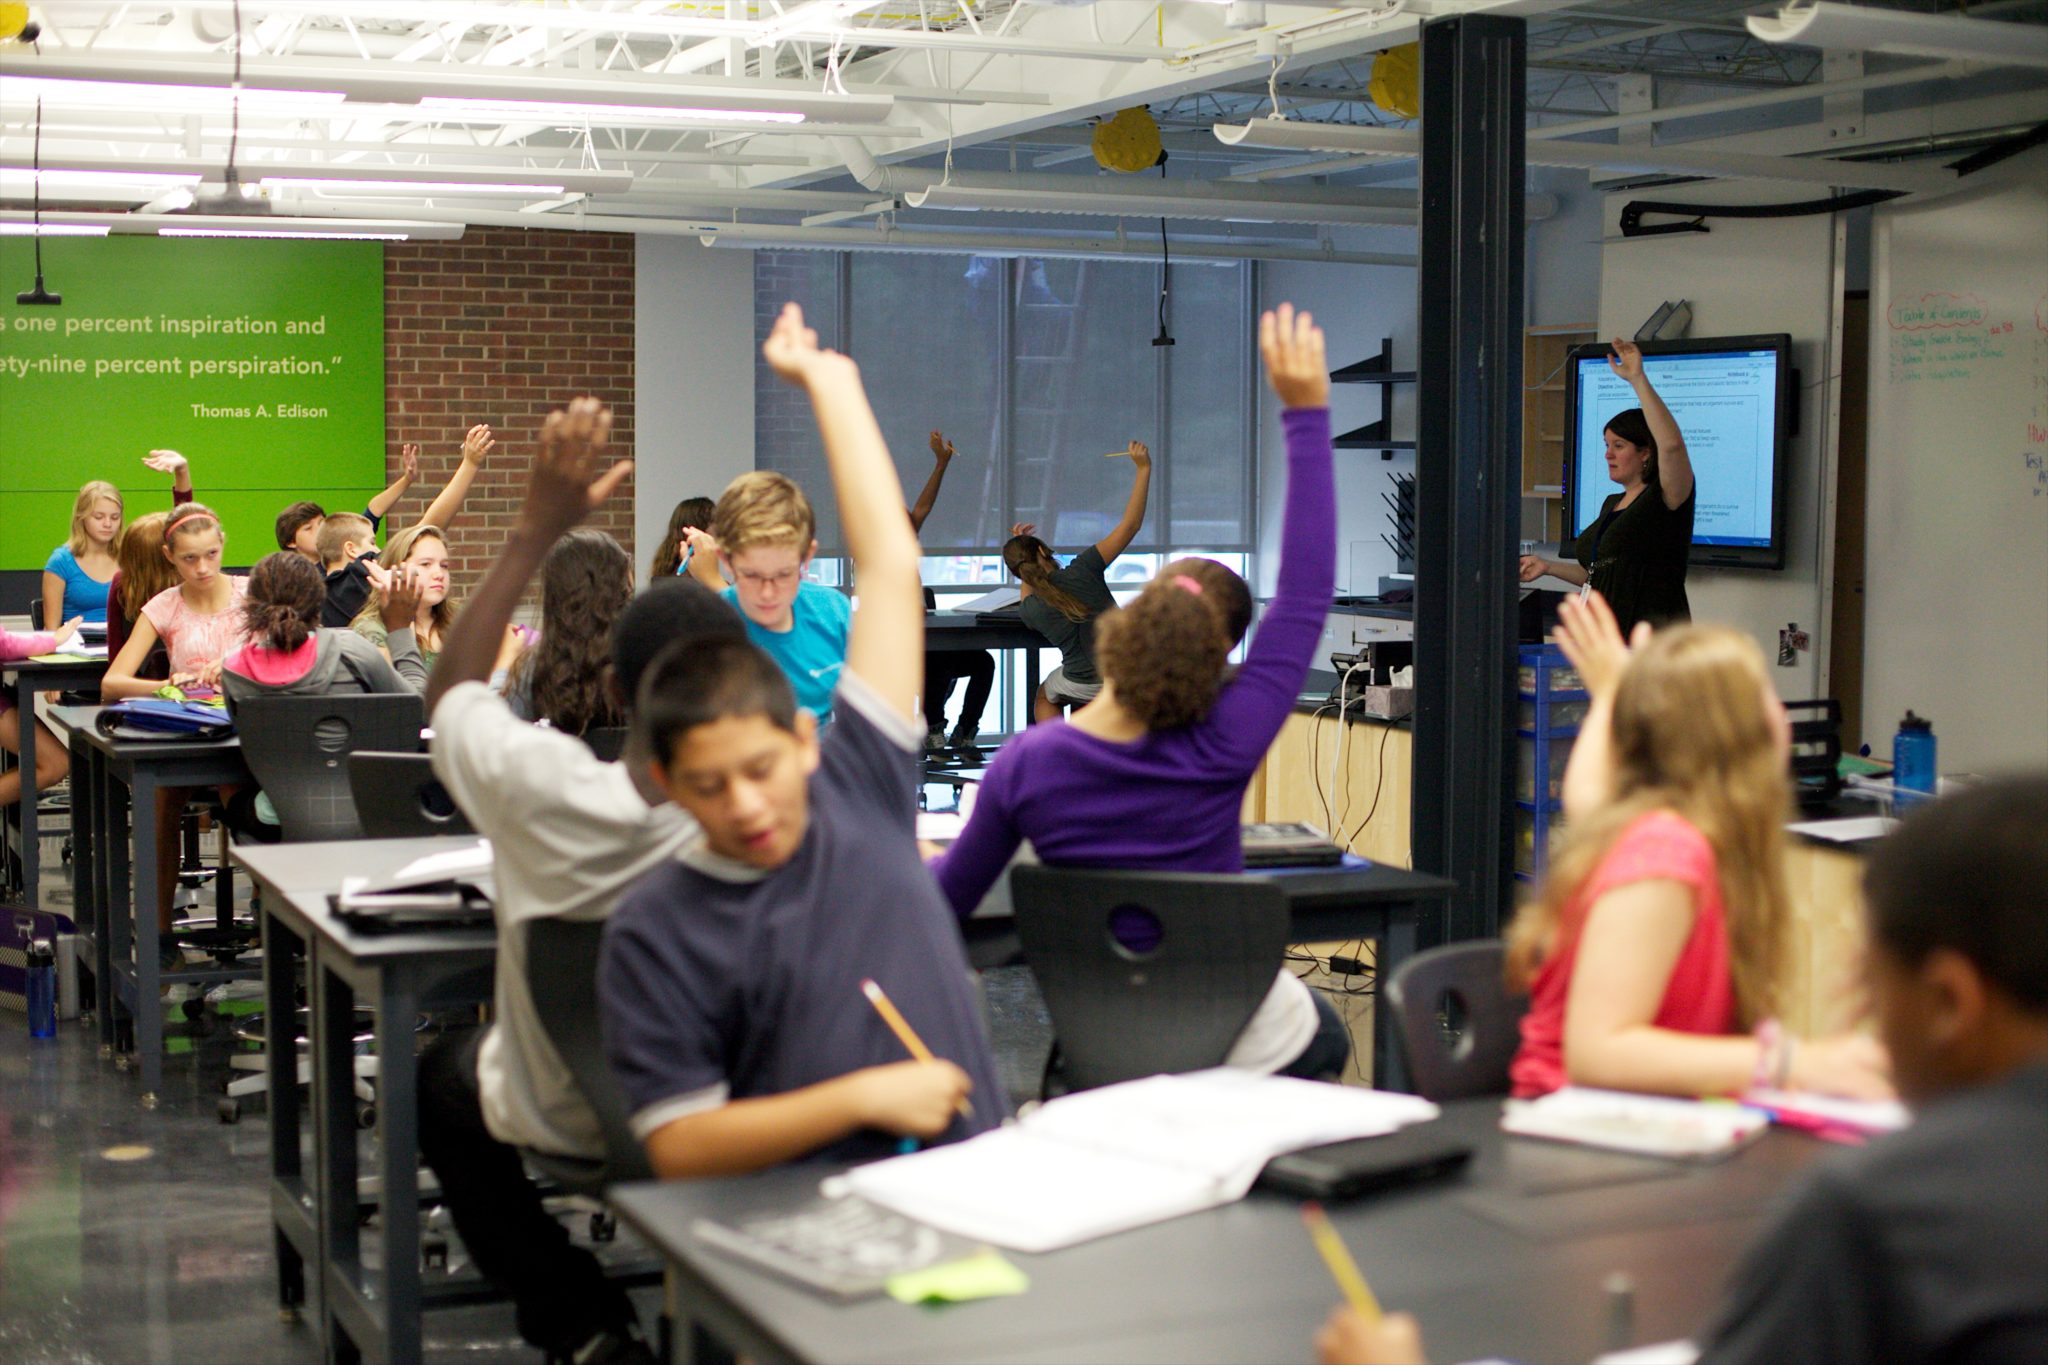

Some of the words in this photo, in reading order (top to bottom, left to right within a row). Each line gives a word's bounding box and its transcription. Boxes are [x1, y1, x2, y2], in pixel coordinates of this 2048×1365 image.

[13, 316, 57, 332] one
[64, 315, 154, 337] percent
[160, 313, 278, 339] inspiration
[284, 314, 326, 335] and
[94, 356, 183, 379] percent
[190, 402, 251, 419] Thomas
[254, 403, 272, 419] A.
[276, 403, 329, 419] Edison
